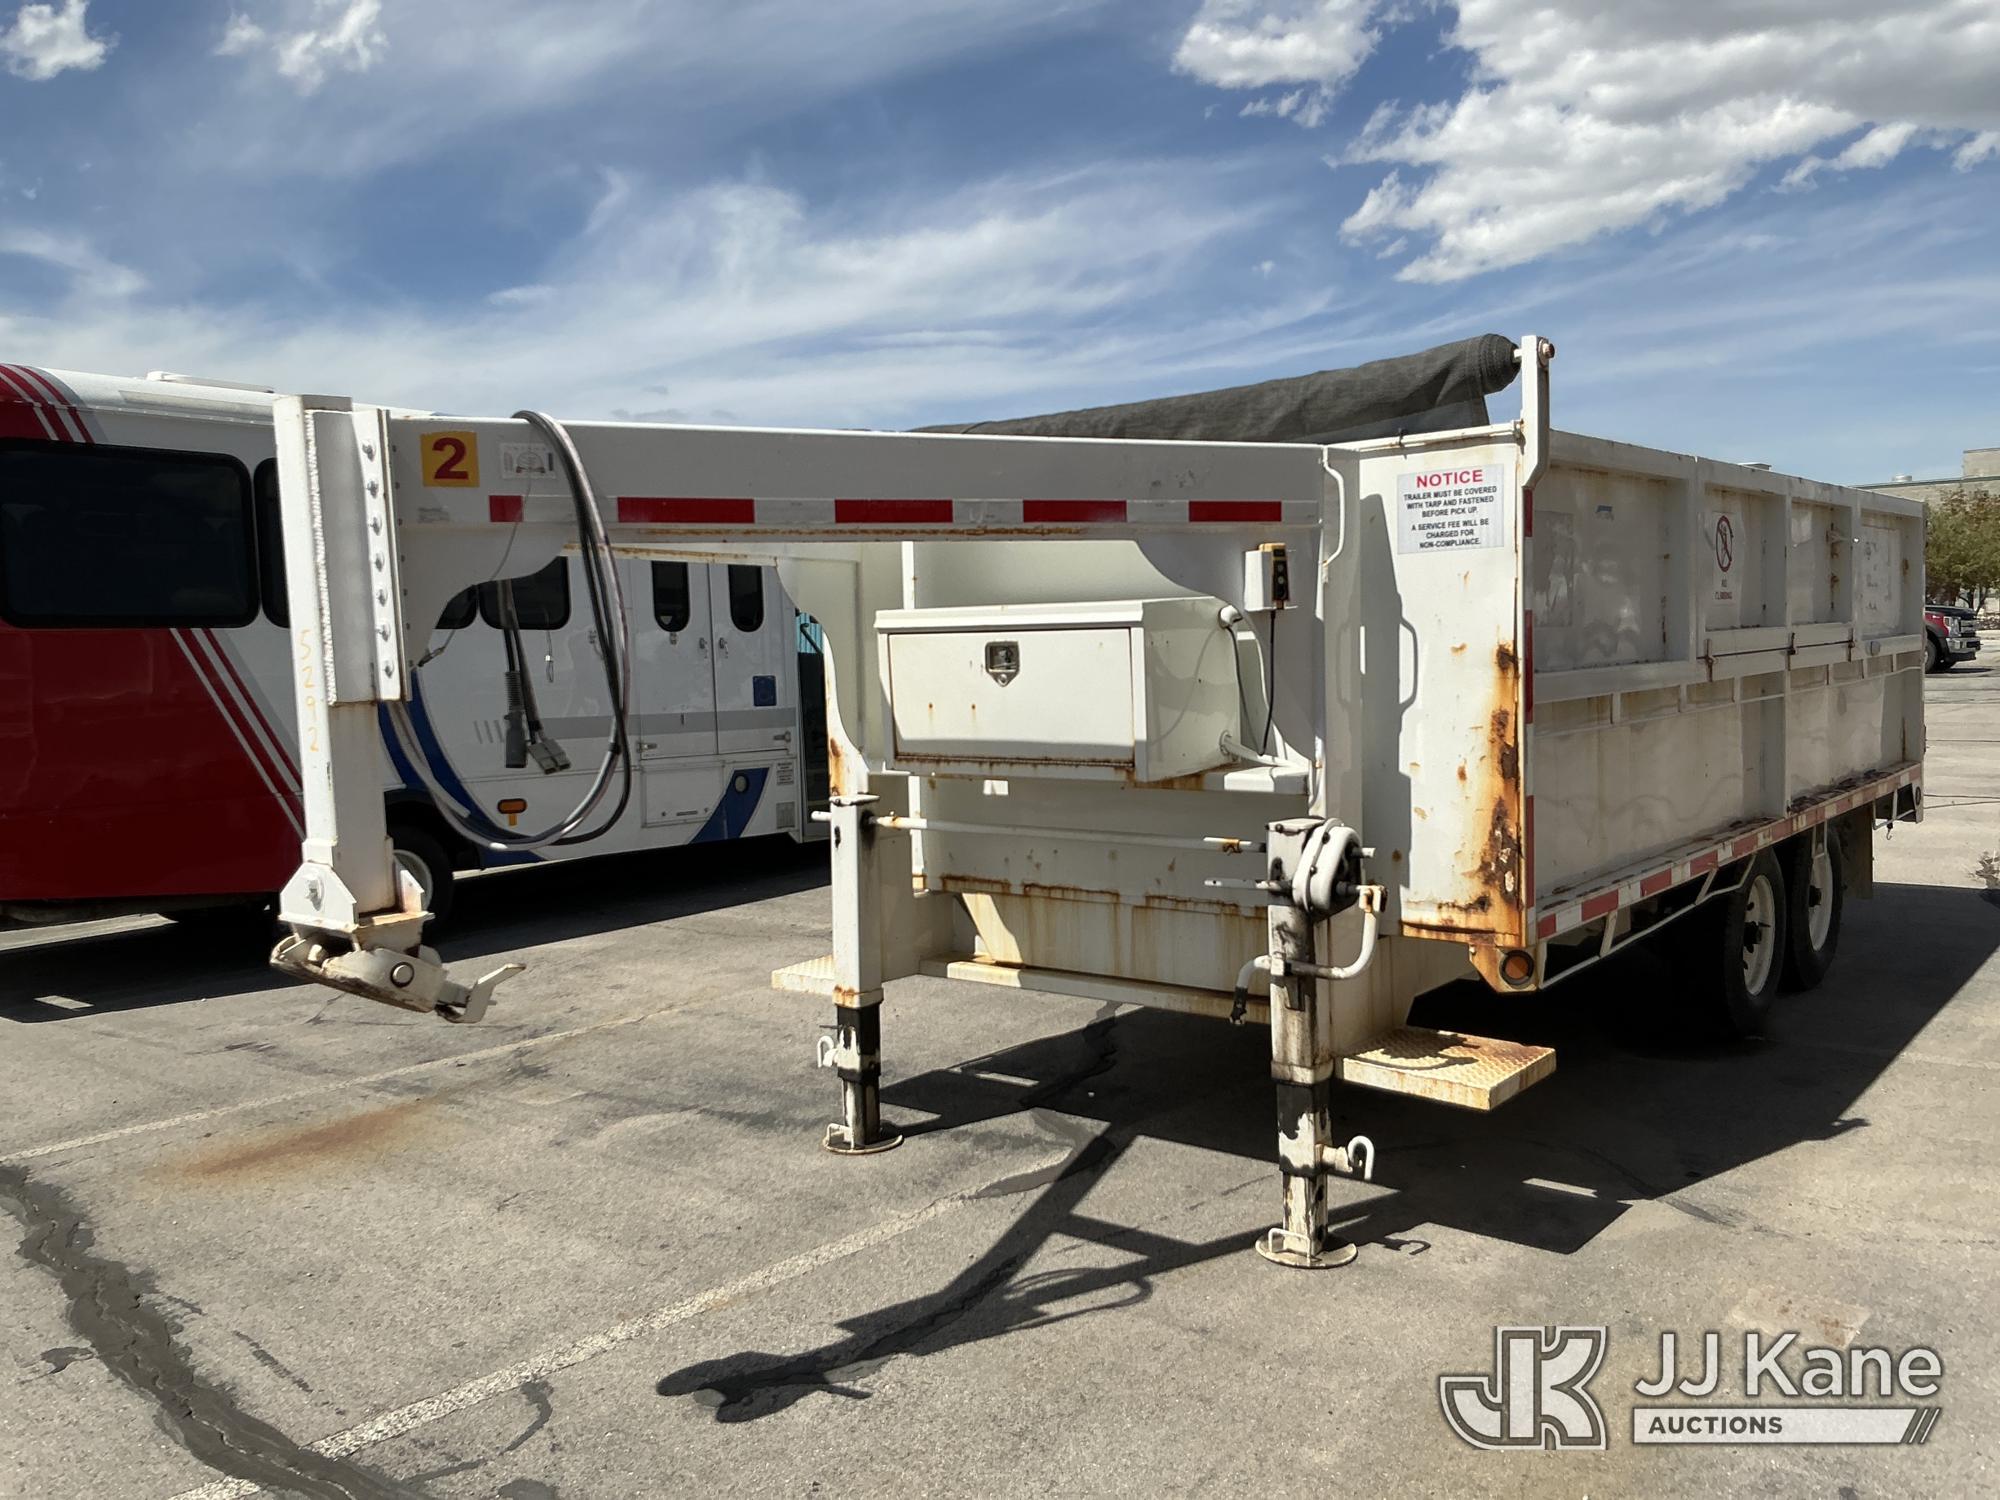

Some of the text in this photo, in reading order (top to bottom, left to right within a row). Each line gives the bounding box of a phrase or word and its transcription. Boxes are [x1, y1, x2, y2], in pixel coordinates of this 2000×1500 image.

[432, 437, 469, 480] 2
[1416, 469, 1483, 488] NOTICE
[1404, 486, 1497, 500] TRAILER MUST BE COVERED
[1425, 500, 1442, 508] TARP
[1459, 495, 1494, 504] FASTENED
[1422, 508, 1448, 518] BEFORE
[1450, 507, 1466, 515] PICK
[1418, 521, 1446, 530] SERVICE
[1447, 520, 1460, 528] FEE
[1462, 519, 1477, 527] WILL
[1480, 518, 1489, 526] BE
[1426, 528, 1474, 539] CHARGED FOR
